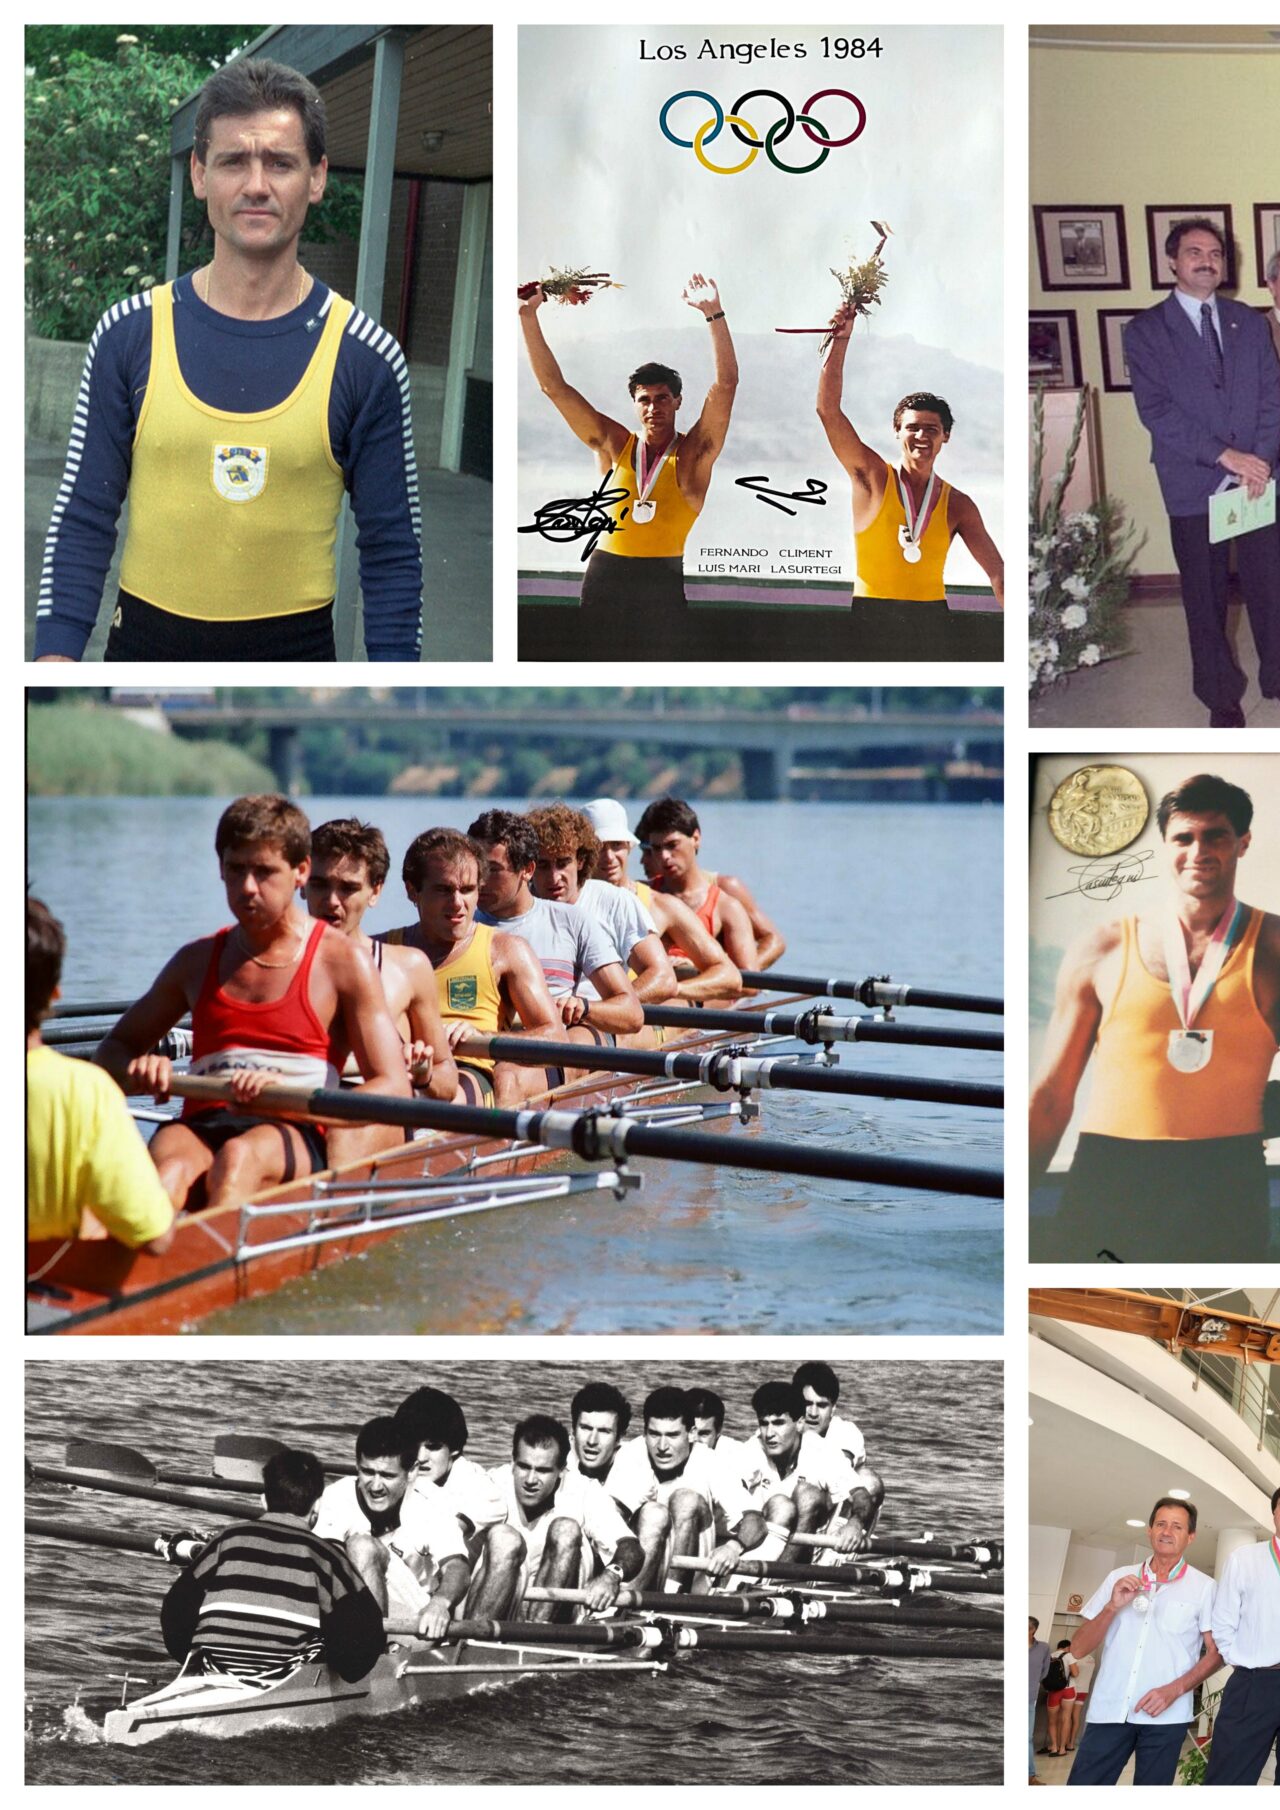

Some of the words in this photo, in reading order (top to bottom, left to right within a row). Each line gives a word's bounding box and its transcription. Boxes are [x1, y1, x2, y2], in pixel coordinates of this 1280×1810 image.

[639, 39, 687, 60] Los
[697, 38, 807, 64] Angeles
[820, 36, 883, 59] 1984
[699, 548, 769, 557] FERNANDO
[778, 549, 833, 558] CLIMENT
[698, 563, 725, 573] LUIS
[729, 564, 761, 573] MARI
[770, 565, 842, 574] LASURTEGI
